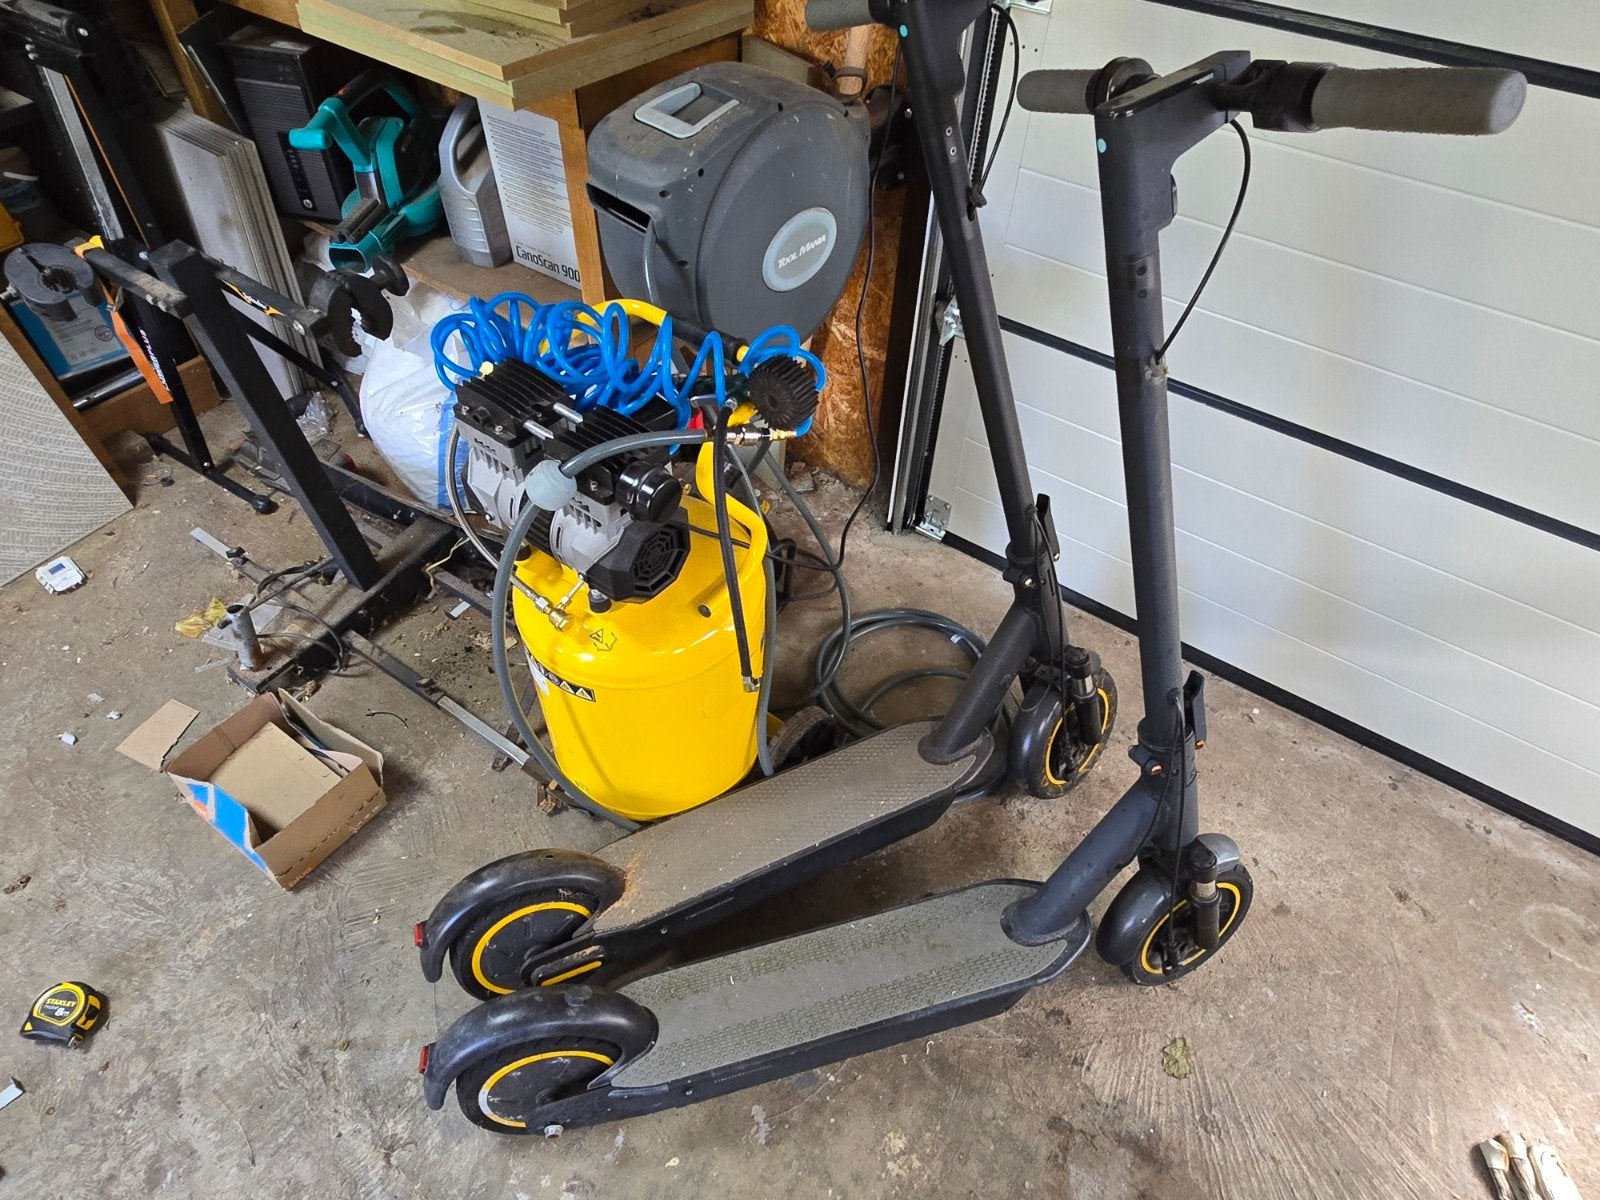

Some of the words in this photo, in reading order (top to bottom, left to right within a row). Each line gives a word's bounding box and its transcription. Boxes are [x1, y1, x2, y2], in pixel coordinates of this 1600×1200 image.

[516, 245, 560, 274] CanoScan
[561, 264, 581, 283] 900
[46, 998, 77, 1008] STANLEY
